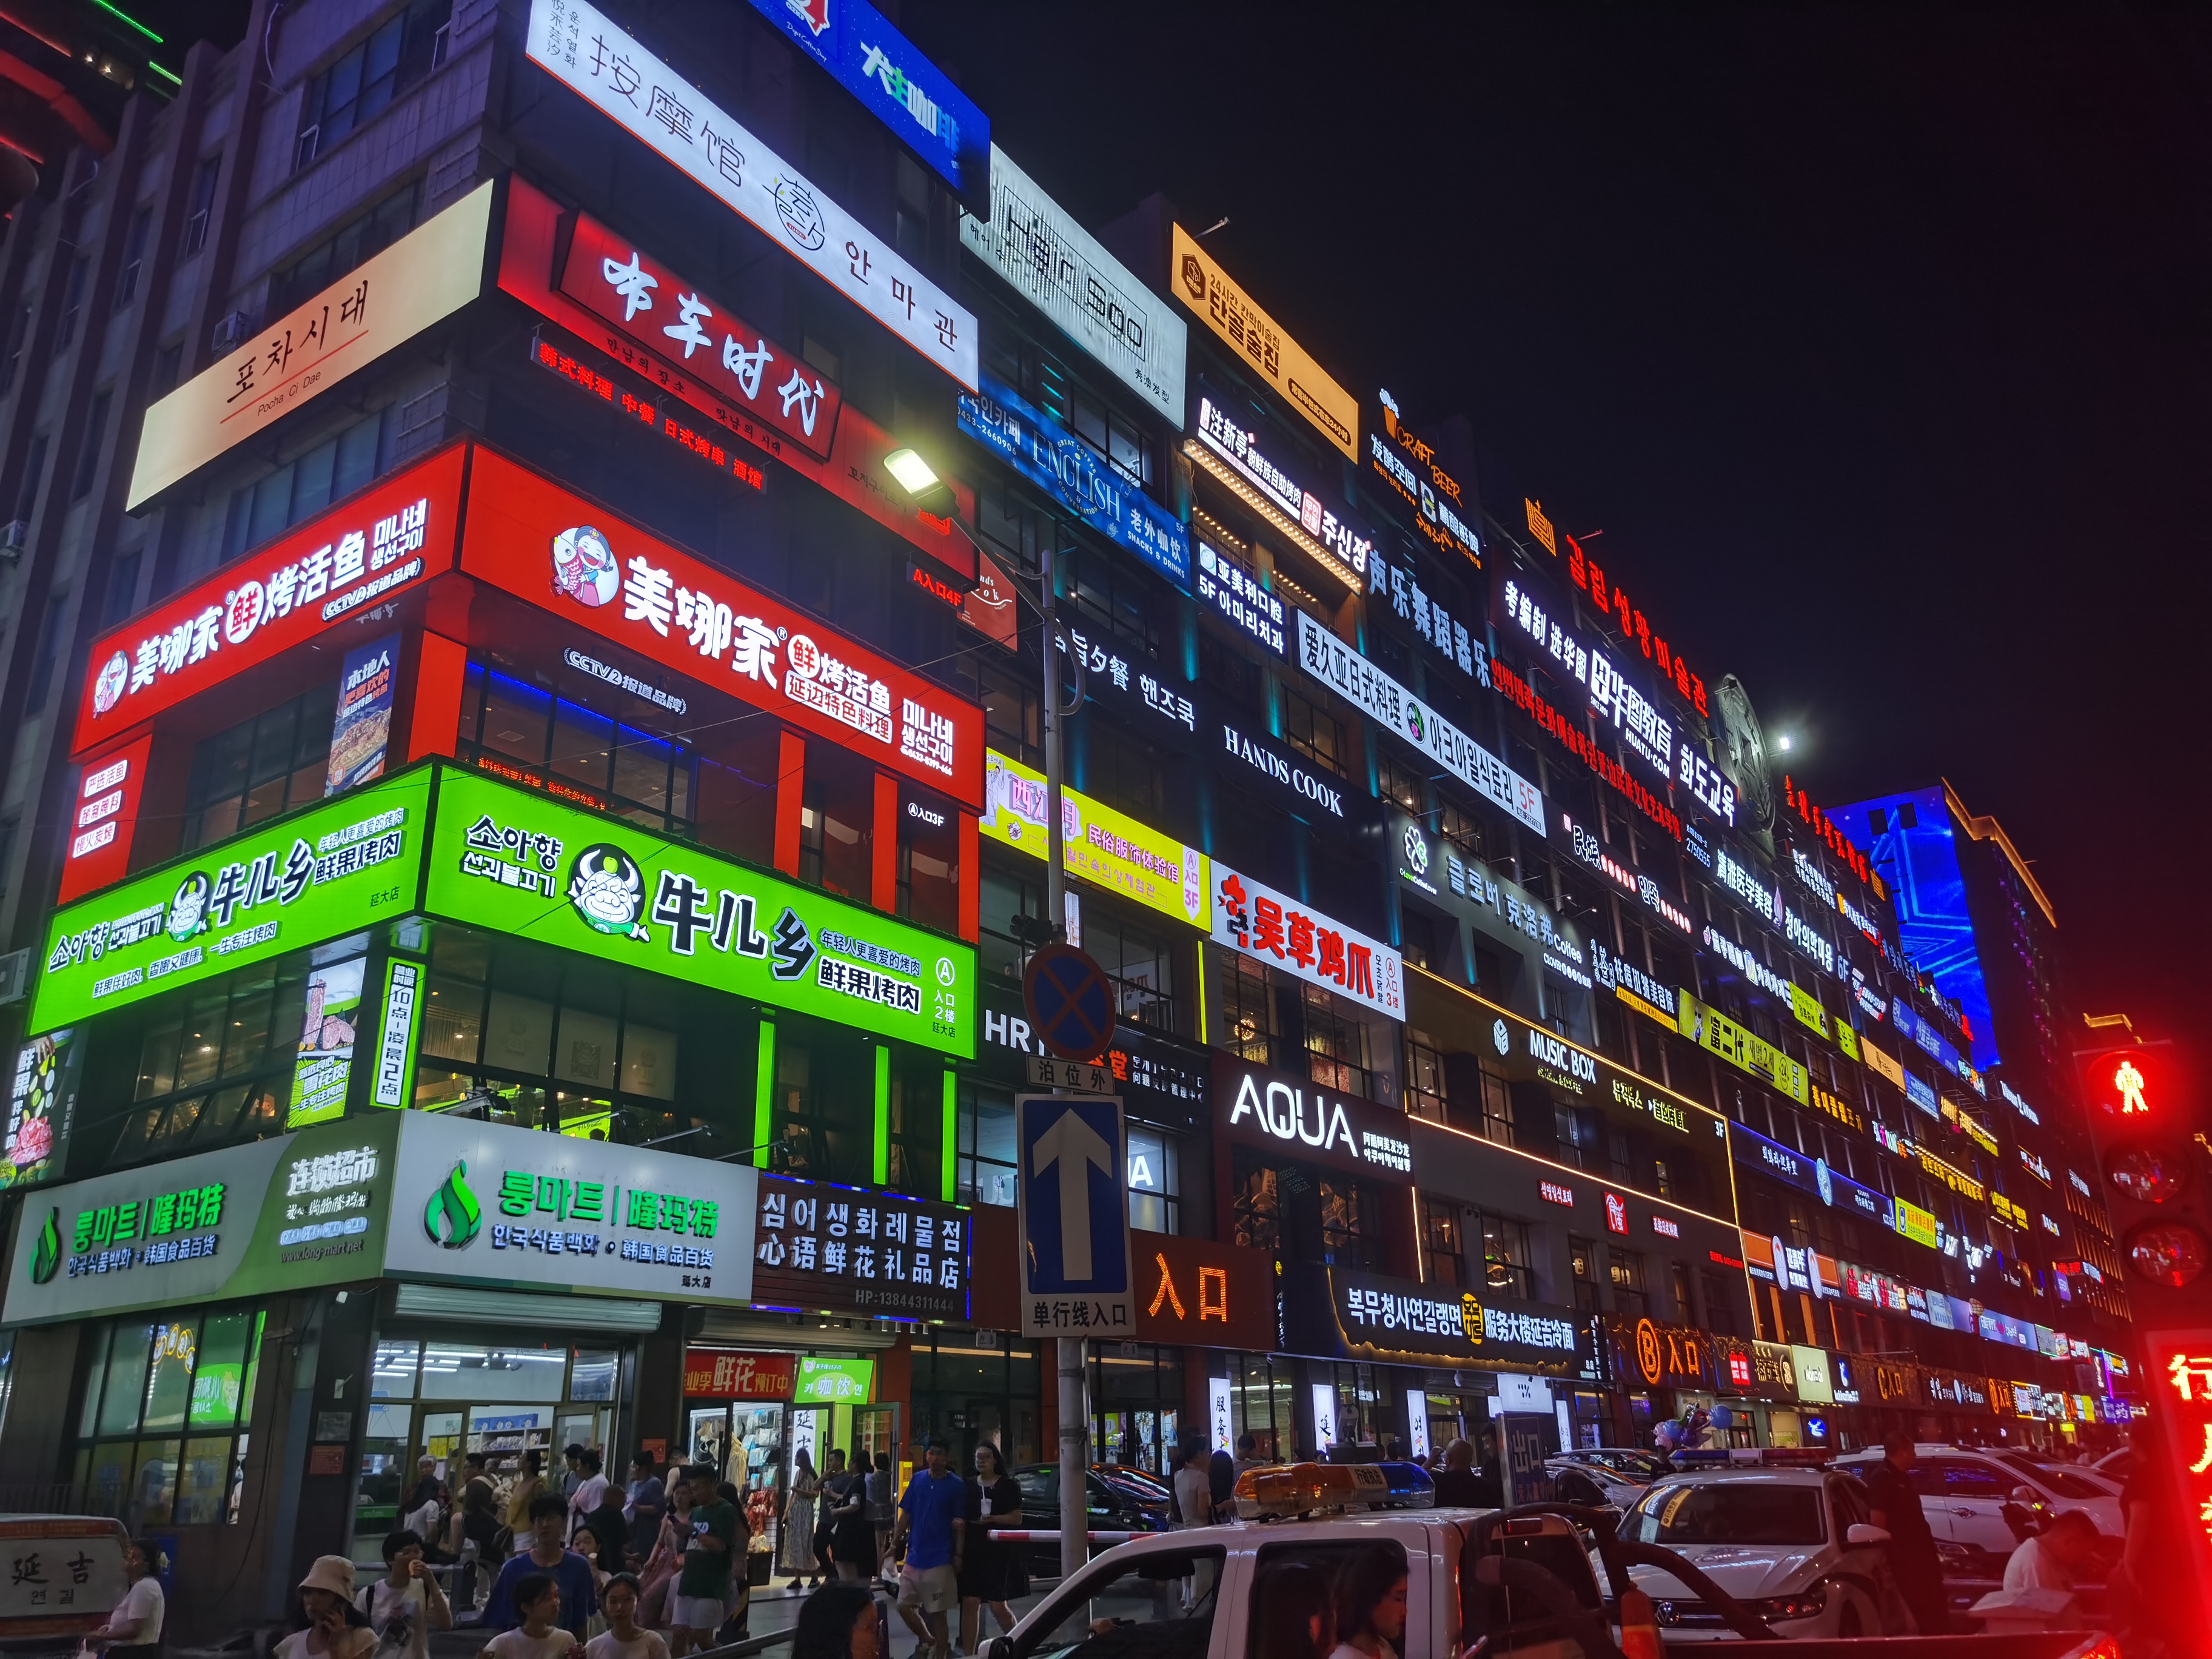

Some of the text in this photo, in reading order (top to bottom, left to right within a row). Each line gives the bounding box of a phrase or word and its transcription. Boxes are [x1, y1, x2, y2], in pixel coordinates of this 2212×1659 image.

[589, 34, 745, 188] 按摩馆
[1007, 204, 1074, 280] Hair
[227, 280, 369, 404] 포차시대
[1209, 288, 1279, 380] 단골술집
[606, 337, 686, 395] 만남의 장소
[257, 392, 284, 417] Pocha
[303, 370, 321, 390] Dae
[538, 343, 763, 490] 韩式料理 中餐 日式烤串 酒馆
[760, 435, 781, 457] 시대
[1057, 438, 1097, 475] GREAT COFFEE
[1370, 433, 1417, 496] 发酵空间
[1396, 426, 1435, 466] CRAFT
[1430, 464, 1463, 508] BEER
[1033, 429, 1121, 523] ENGLISH
[1057, 480, 1099, 515] CONVERSATION
[1247, 447, 1302, 509] 朝鲜族自助烤肉
[373, 498, 427, 548] 미나네
[1130, 508, 1182, 564] 老外咖饮
[1175, 521, 1184, 534] 5F
[1322, 509, 1366, 573] 주신정
[370, 527, 424, 571] 생선구이
[1127, 529, 1185, 579] SNACKS & DRINKS
[1199, 574, 1284, 655] 5F 아미리치과
[1217, 556, 1283, 625] 亚美利口腔
[623, 555, 778, 690] 美娜家
[1369, 549, 1491, 688] 声乐舞蹈器乐
[1504, 580, 1587, 685] 考编制 选华图
[131, 605, 224, 695] 美娜家
[346, 649, 391, 691] 本地人
[342, 683, 389, 718] 延边特色烤鱼
[344, 668, 390, 706] 更喜欢的
[789, 674, 890, 742] 延边特色料理
[1139, 674, 1195, 732] 핸즈쿡
[903, 699, 954, 738] 미나네
[1609, 669, 1672, 762] 华图教育
[902, 720, 954, 766] 생선구이
[85, 762, 127, 797] 严选活鱼
[1223, 725, 1344, 817] HANDS COOK
[1679, 743, 1735, 828] 화도교육
[80, 792, 121, 825] 秘制腌料
[1518, 780, 1536, 814] 5F
[319, 807, 404, 853] 年轻人更喜爱的烤肉
[466, 814, 564, 873] 소아향
[1087, 822, 1180, 885] 民俗服饰体验馆
[210, 837, 313, 928] 牛儿乡
[315, 830, 401, 885] 鲜果烤肉
[1184, 869, 1199, 886] 入口
[369, 886, 400, 908] 延大店
[1184, 888, 1199, 909] 3F
[49, 921, 110, 973] 소아향
[209, 921, 278, 955] 一生专注烤肉
[652, 868, 818, 982] 牛儿乡
[1505, 894, 1553, 947] 克洛弗
[1553, 934, 1583, 964] Coffee
[1785, 906, 1834, 973] 청아의학미용
[1837, 954, 1849, 983] 6F
[394, 964, 416, 977] 营业
[820, 928, 922, 979] 年轻人更喜爱的烤肉
[393, 973, 415, 987] 时间
[818, 957, 922, 1016] 鲜果烤肉
[934, 988, 955, 1008] 入口
[1386, 977, 1398, 993] 入口
[1386, 992, 1399, 1010] 3楼
[931, 1021, 957, 1039] 延大店
[934, 1004, 955, 1025] 2楼
[1710, 1015, 1744, 1064] 富二代
[301, 1059, 349, 1094] 雪花肉
[1038, 1059, 1107, 1091] 泊位外
[1530, 1029, 1597, 1085] MUSIC BOX
[1230, 1074, 1359, 1158] AQUA
[1363, 1131, 1410, 1158] 阿酷阿美发沙龙
[1363, 1148, 1411, 1172] 아쿠아헤어살롱
[287, 1145, 379, 1198] 连锁超市
[72, 1201, 138, 1254] 룽마트
[150, 1182, 226, 1236] 隆玛特
[499, 1170, 720, 1238] 룽마트 隆玛特
[762, 1192, 961, 1253] 심어생화례물점
[67, 1233, 217, 1277] 한국식품백화 韩国食品百货
[492, 1223, 715, 1269] 한국식품백화 韩国食品百货
[757, 1233, 960, 1290] 心语鲜花礼品店
[682, 1275, 712, 1289] 延大店
[855, 1289, 954, 1313] HP:13844311444
[1149, 1253, 1228, 1322] 入口
[1033, 1301, 1127, 1328] 单行线入口
[1347, 1287, 1463, 1337] 복무청사연길랭면
[1484, 1308, 1575, 1351] 服务大楼延吉冷面
[1668, 1335, 1700, 1375] 入口
[12, 1550, 95, 1586] 延吉
[30, 1587, 75, 1606] 연길
